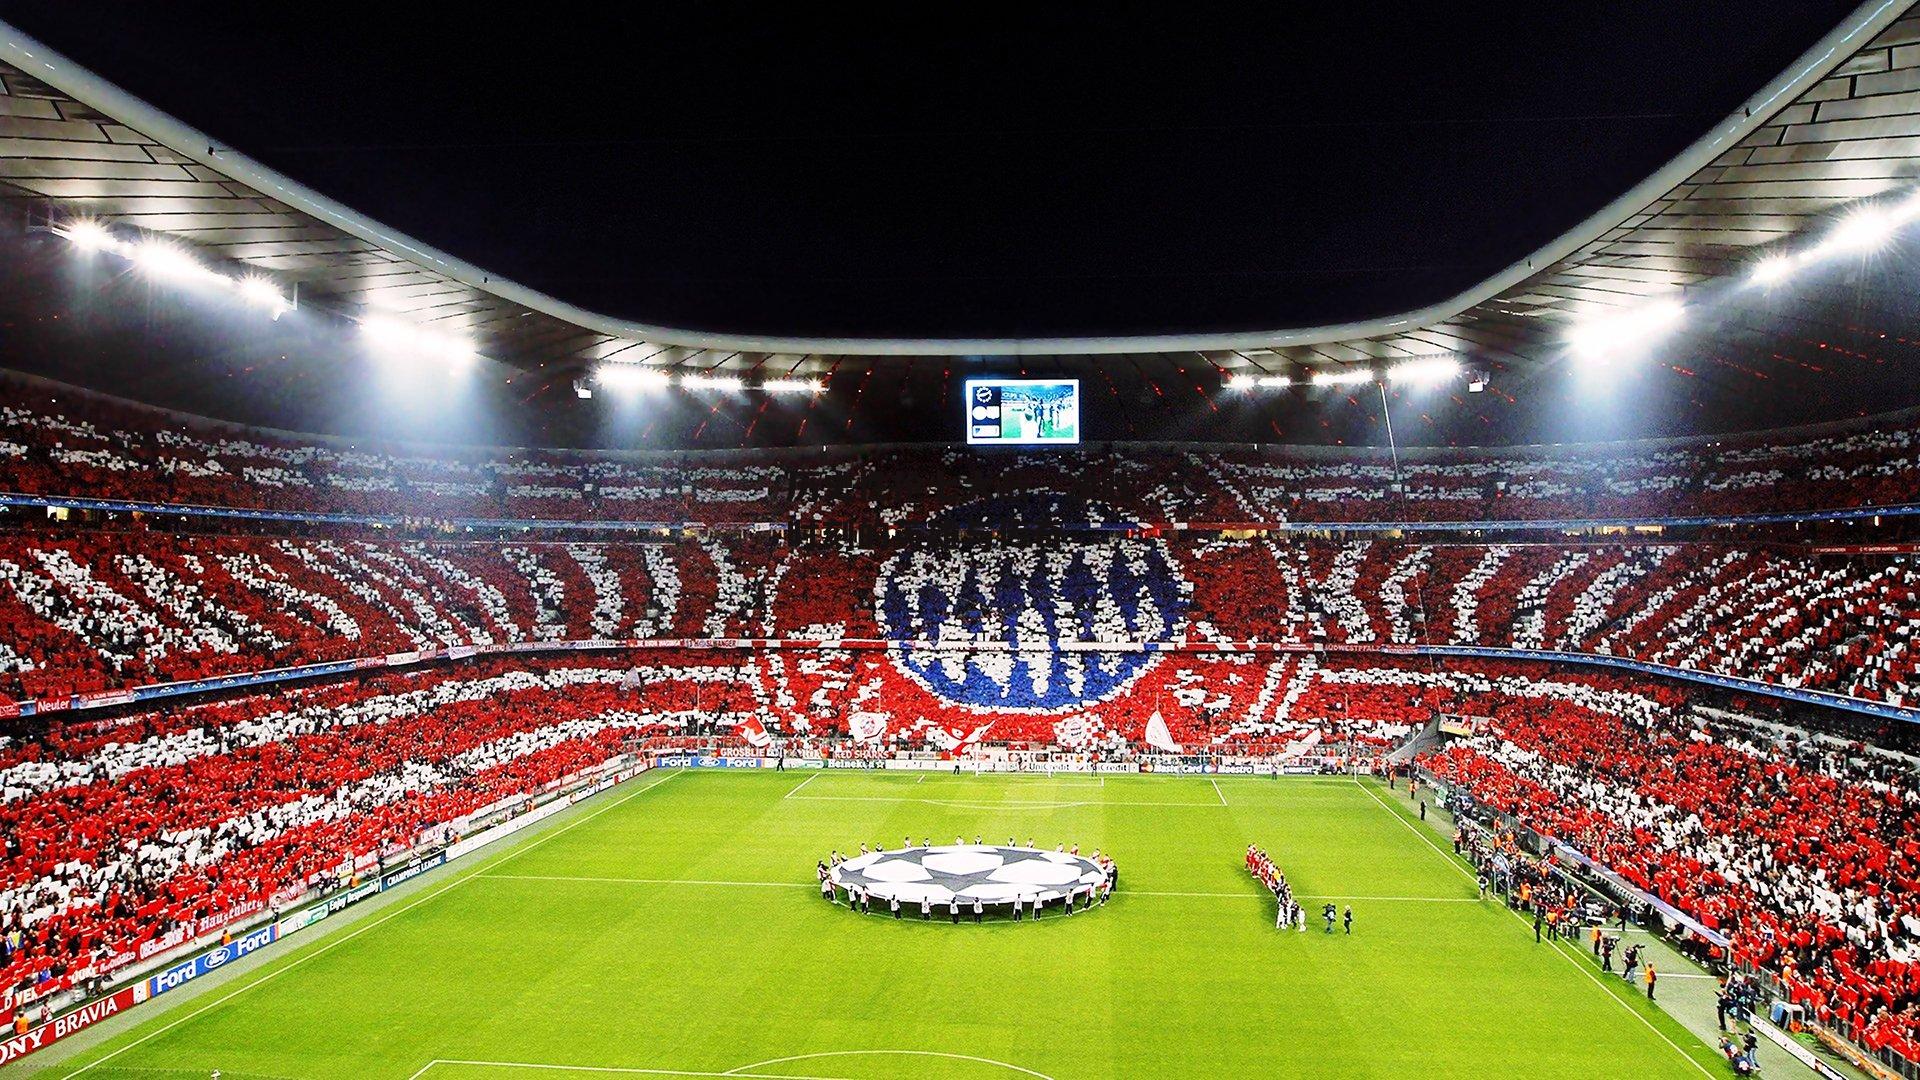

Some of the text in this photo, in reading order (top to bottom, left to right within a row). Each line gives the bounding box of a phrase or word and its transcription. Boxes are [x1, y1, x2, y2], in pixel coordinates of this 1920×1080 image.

[37, 699, 70, 713] Neuler
[854, 750, 889, 759] SHARKS
[661, 757, 692, 767] Ford
[726, 757, 756, 767] Ford
[1029, 762, 1070, 771] UniCedit
[1086, 762, 1127, 772] UiCredit
[387, 865, 421, 886] CHAMPIONS
[421, 856, 442, 872] LEAGUE
[329, 896, 347, 911] Enjoy
[237, 928, 271, 956] Ford
[156, 959, 196, 993] Ford
[55, 997, 118, 1039] BRAVIA
